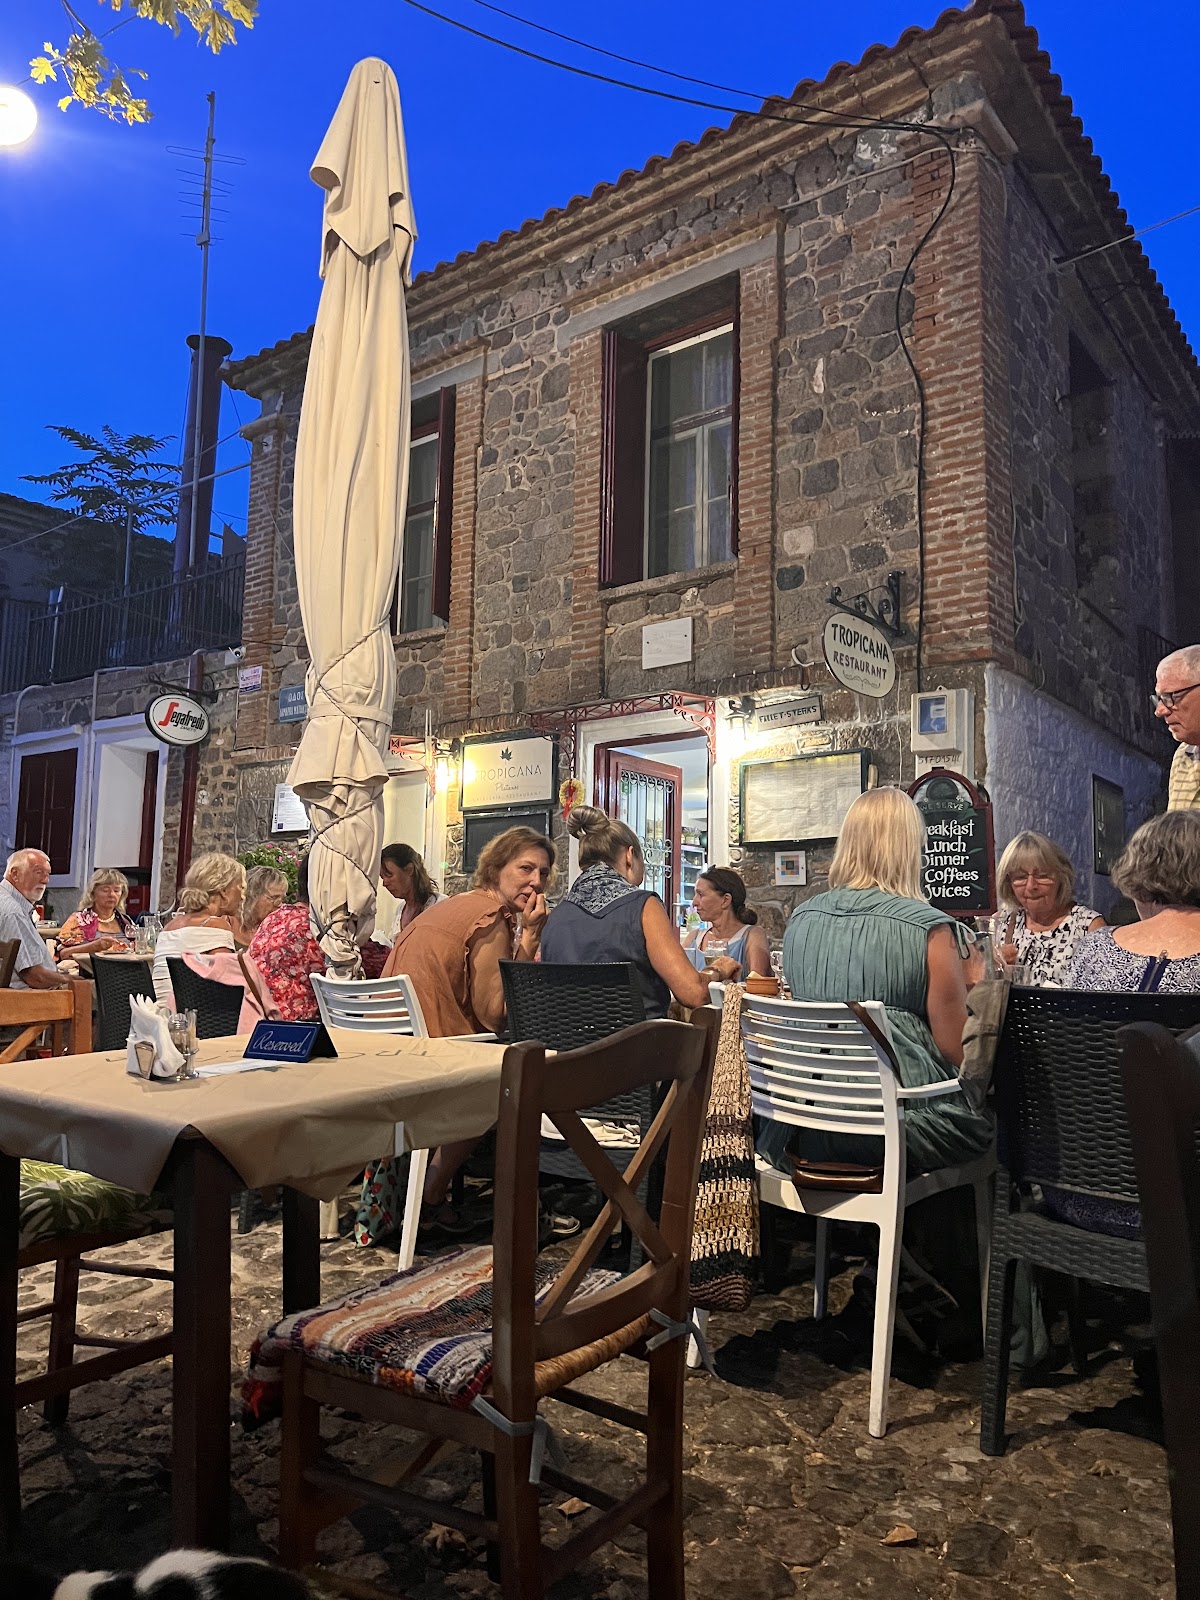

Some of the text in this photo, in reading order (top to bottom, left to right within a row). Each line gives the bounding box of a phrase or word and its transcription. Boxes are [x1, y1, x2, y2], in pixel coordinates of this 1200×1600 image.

[831, 623, 890, 663] TROPICANA
[832, 654, 888, 680] RESTAURANT
[158, 701, 205, 730] Segafredo
[920, 801, 964, 811] WE SERVE
[926, 819, 975, 838] eakfast
[925, 836, 967, 853] Lunch
[925, 867, 979, 884] Coffees
[924, 884, 971, 901] Juices
[252, 1030, 312, 1052] Reserved
